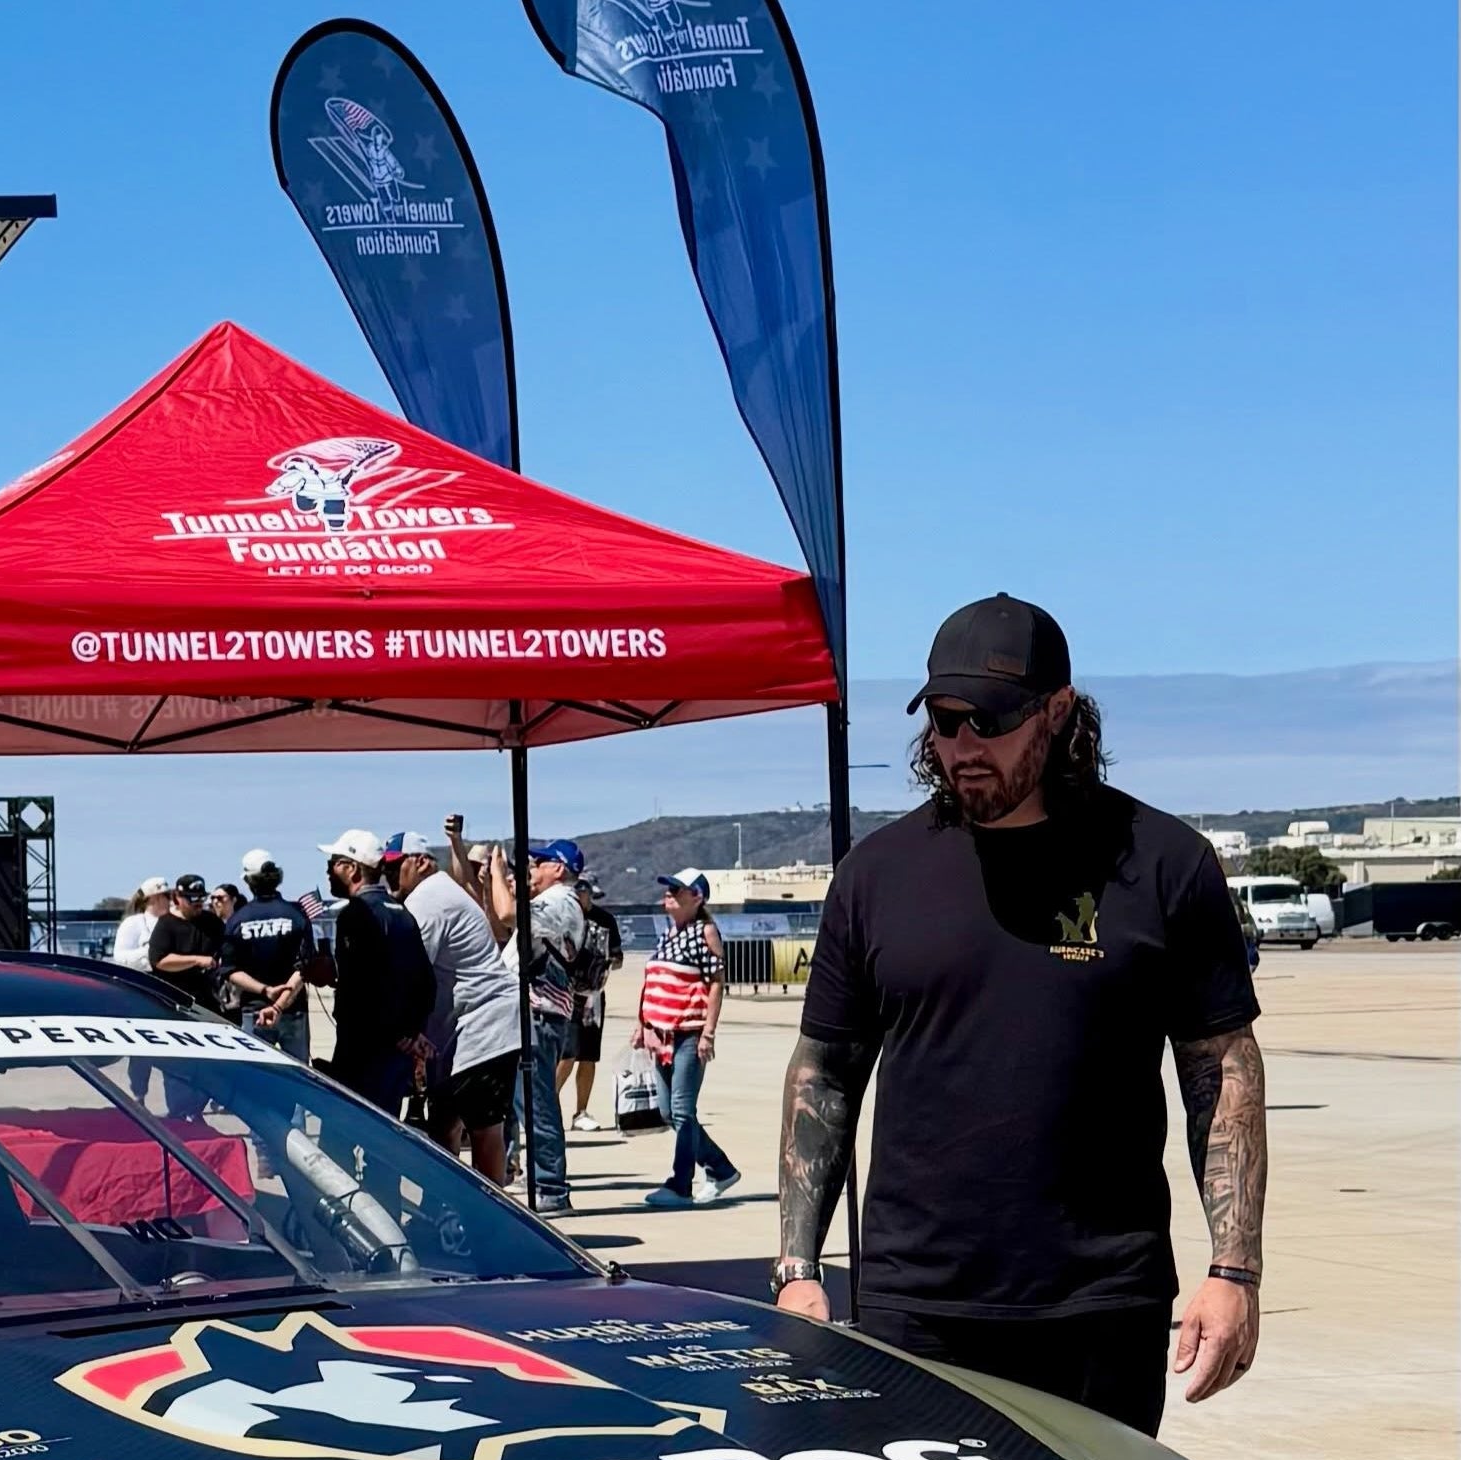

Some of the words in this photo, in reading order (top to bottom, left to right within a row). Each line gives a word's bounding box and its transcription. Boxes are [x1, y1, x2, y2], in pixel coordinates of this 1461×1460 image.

[161, 509, 298, 535] Tunnel
[350, 505, 494, 531] Towers
[227, 533, 447, 564] Foundation
[267, 565, 305, 577] LET
[310, 565, 338, 576] US
[344, 564, 372, 576] DO
[377, 563, 433, 575] GOOD
[71, 630, 375, 662] @TUNNEL2TOWERS
[385, 628, 667, 659] #TUNNEL2TOWERS
[241, 920, 292, 939] STAFF
[506, 1319, 751, 1342] HURRICANE
[626, 1347, 791, 1369] MATTIS
[740, 1378, 849, 1395] BAX
